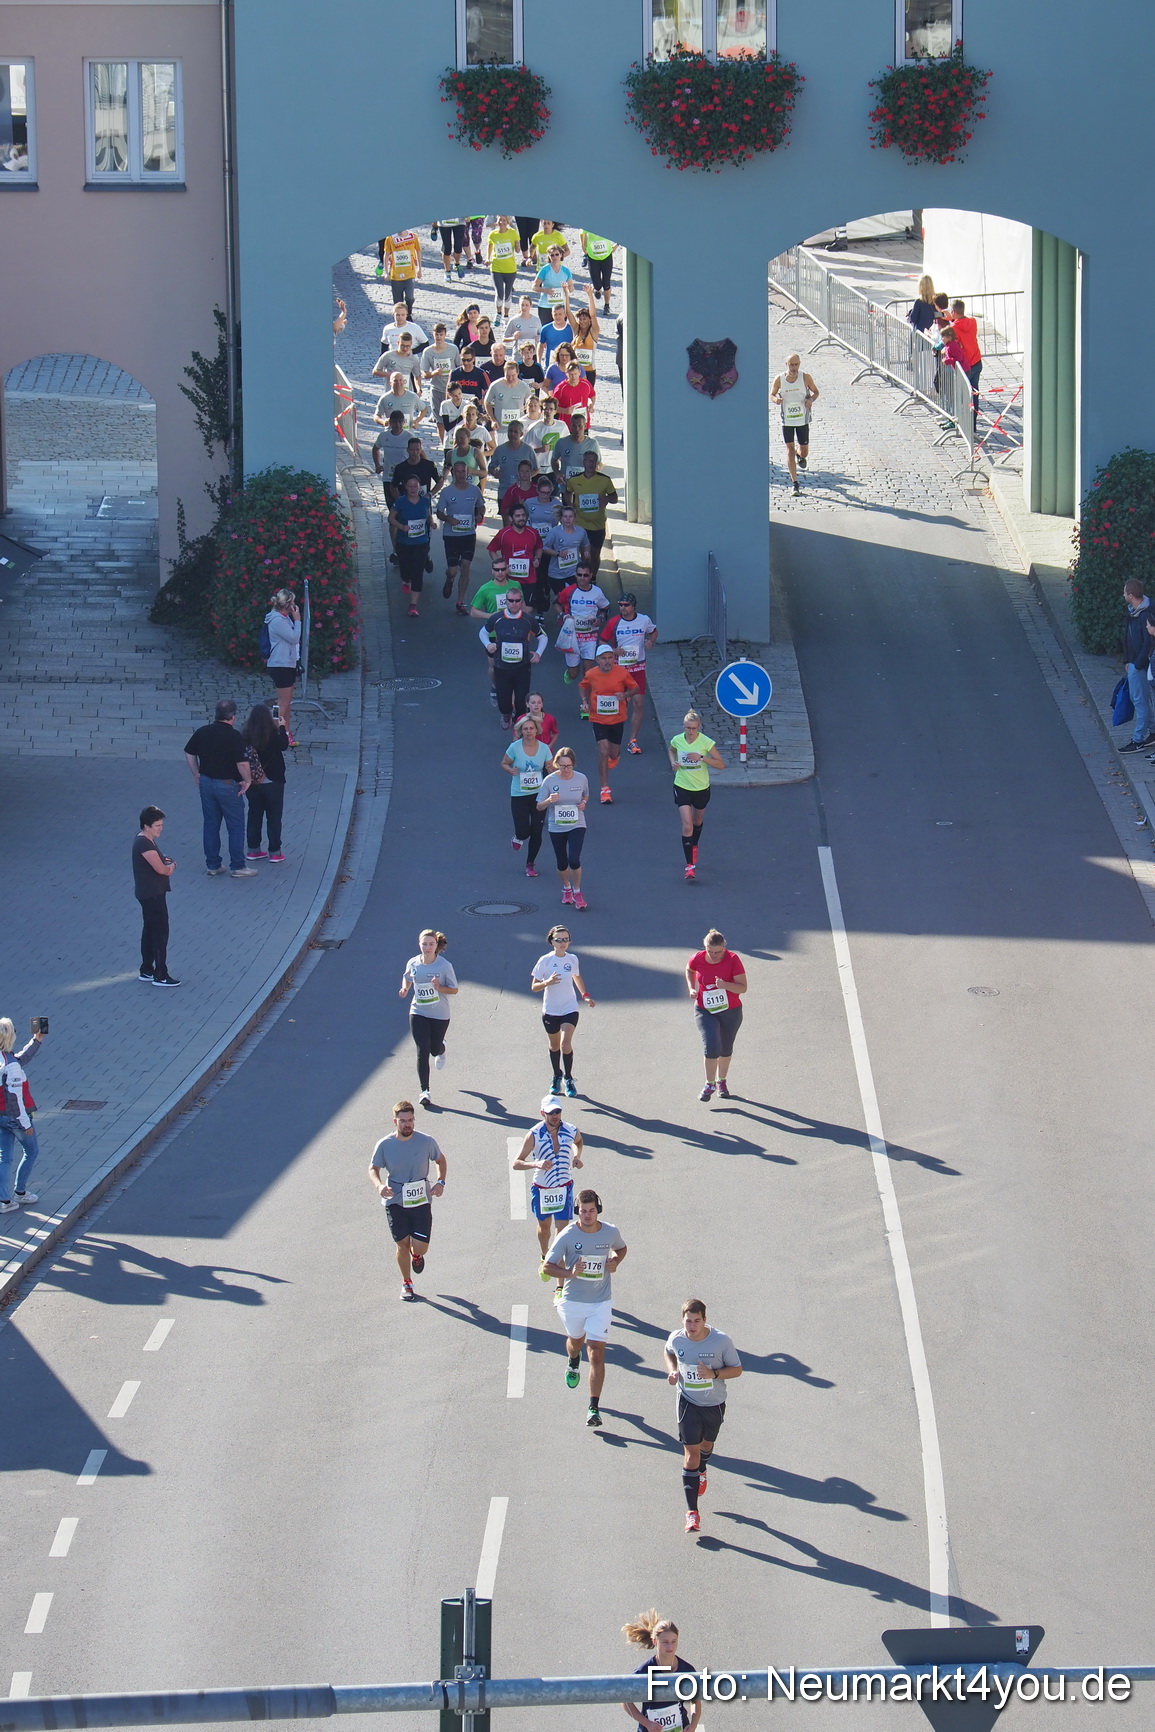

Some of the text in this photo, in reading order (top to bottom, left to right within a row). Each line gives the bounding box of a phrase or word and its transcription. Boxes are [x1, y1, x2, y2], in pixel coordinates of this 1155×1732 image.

[600, 700, 615, 708] 5081
[523, 777, 539, 785] 5021
[558, 810, 575, 818] 5060
[417, 988, 434, 997] 5010
[706, 994, 725, 1005] 5119
[406, 1187, 424, 1197] 5012
[544, 1194, 564, 1203] 5018
